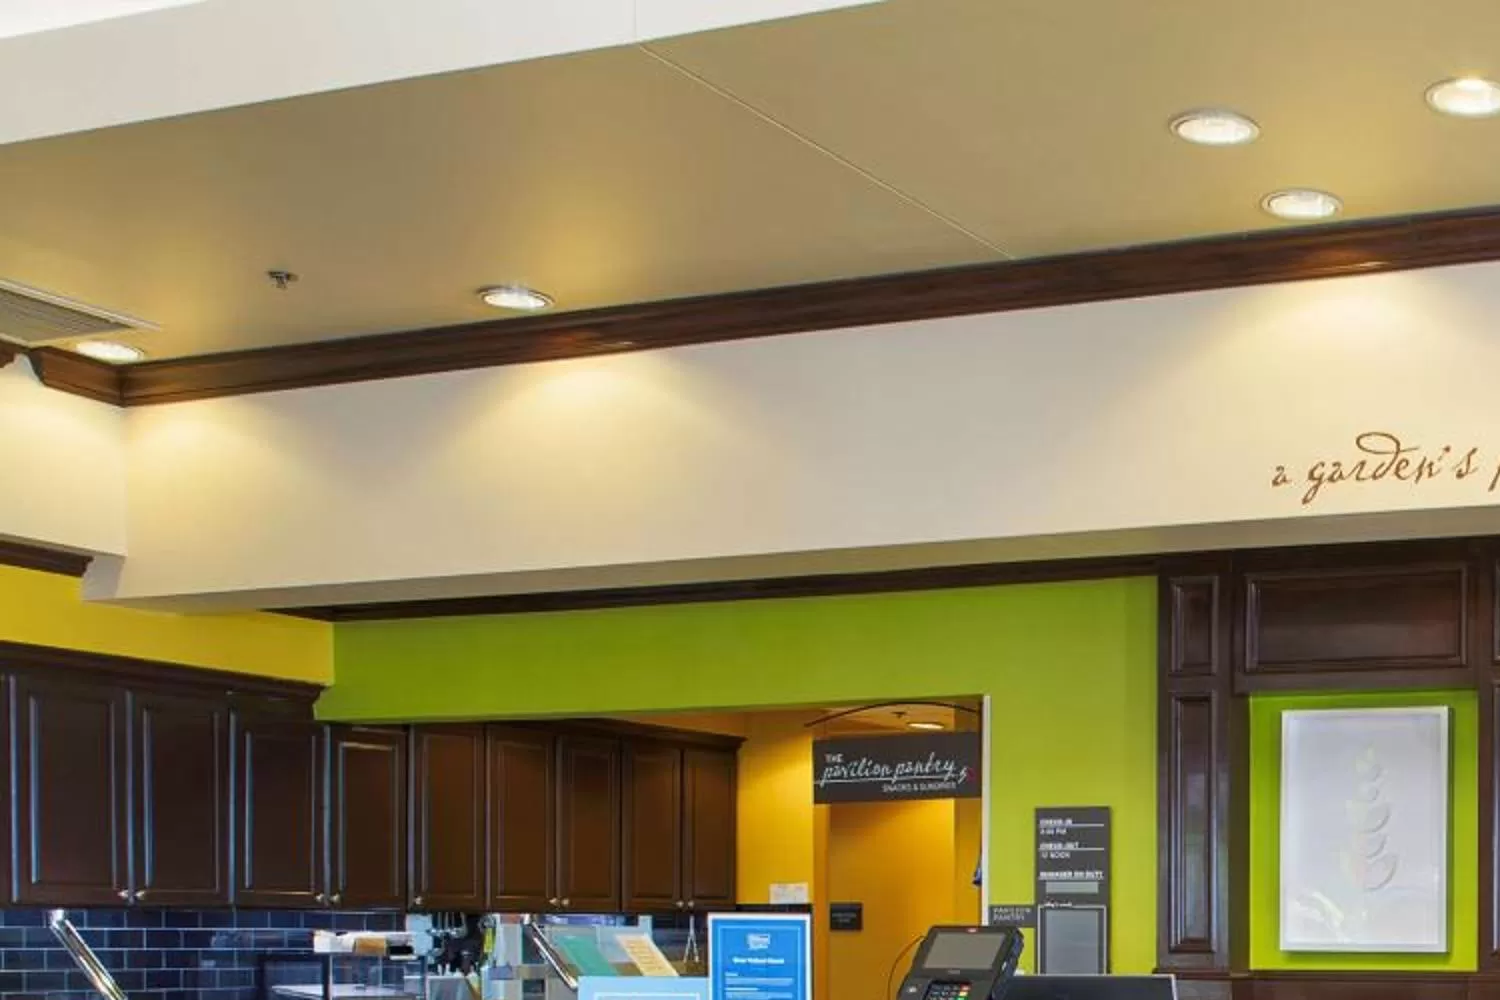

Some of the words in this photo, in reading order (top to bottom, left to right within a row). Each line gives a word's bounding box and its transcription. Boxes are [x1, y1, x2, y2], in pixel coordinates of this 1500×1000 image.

[1271, 464, 1293, 487] a
[1301, 431, 1479, 506] garden's
[819, 756, 892, 788] pavilion
[891, 751, 958, 784] pantry
[824, 753, 844, 763] THE
